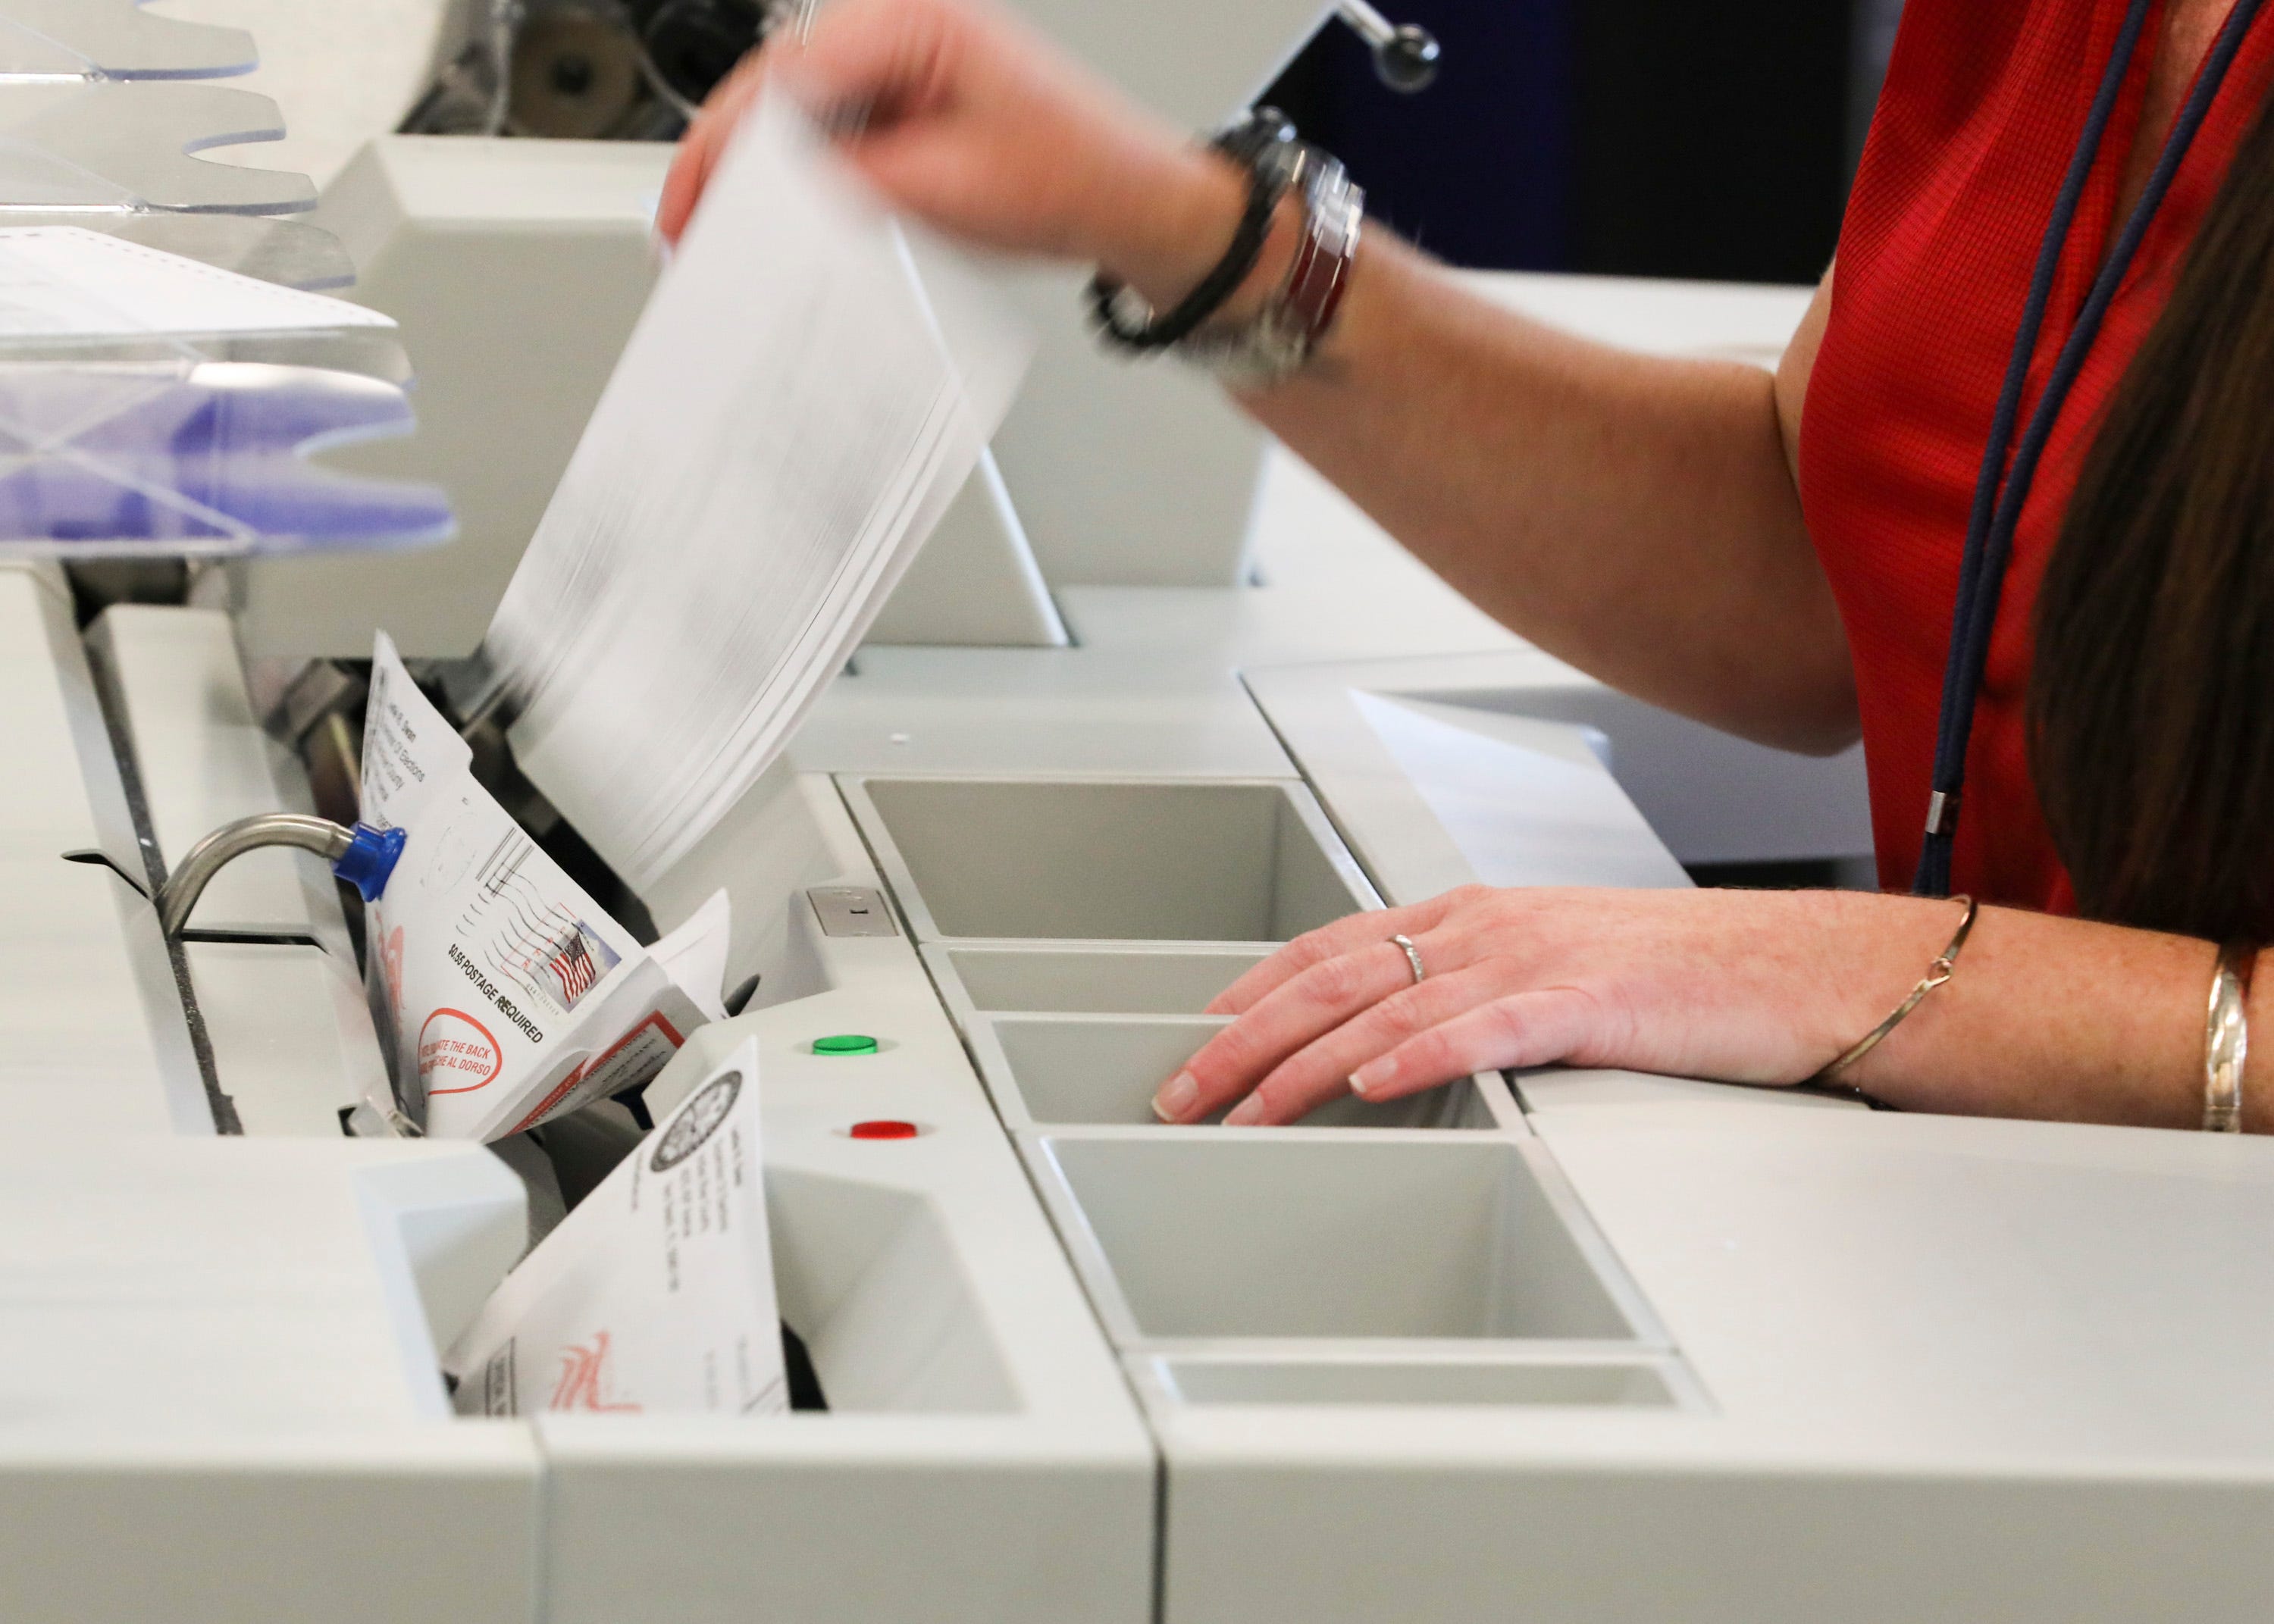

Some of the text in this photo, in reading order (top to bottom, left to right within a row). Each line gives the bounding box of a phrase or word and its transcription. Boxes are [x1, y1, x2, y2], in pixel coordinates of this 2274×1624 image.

[399, 749, 425, 783] Elections
[448, 943, 543, 1044] $0.55 POSTAGE REQUIRED
[449, 1040, 467, 1053] THE
[465, 1044, 492, 1059] BACK
[446, 1056, 457, 1069] AL
[457, 1059, 492, 1077] DORSO
